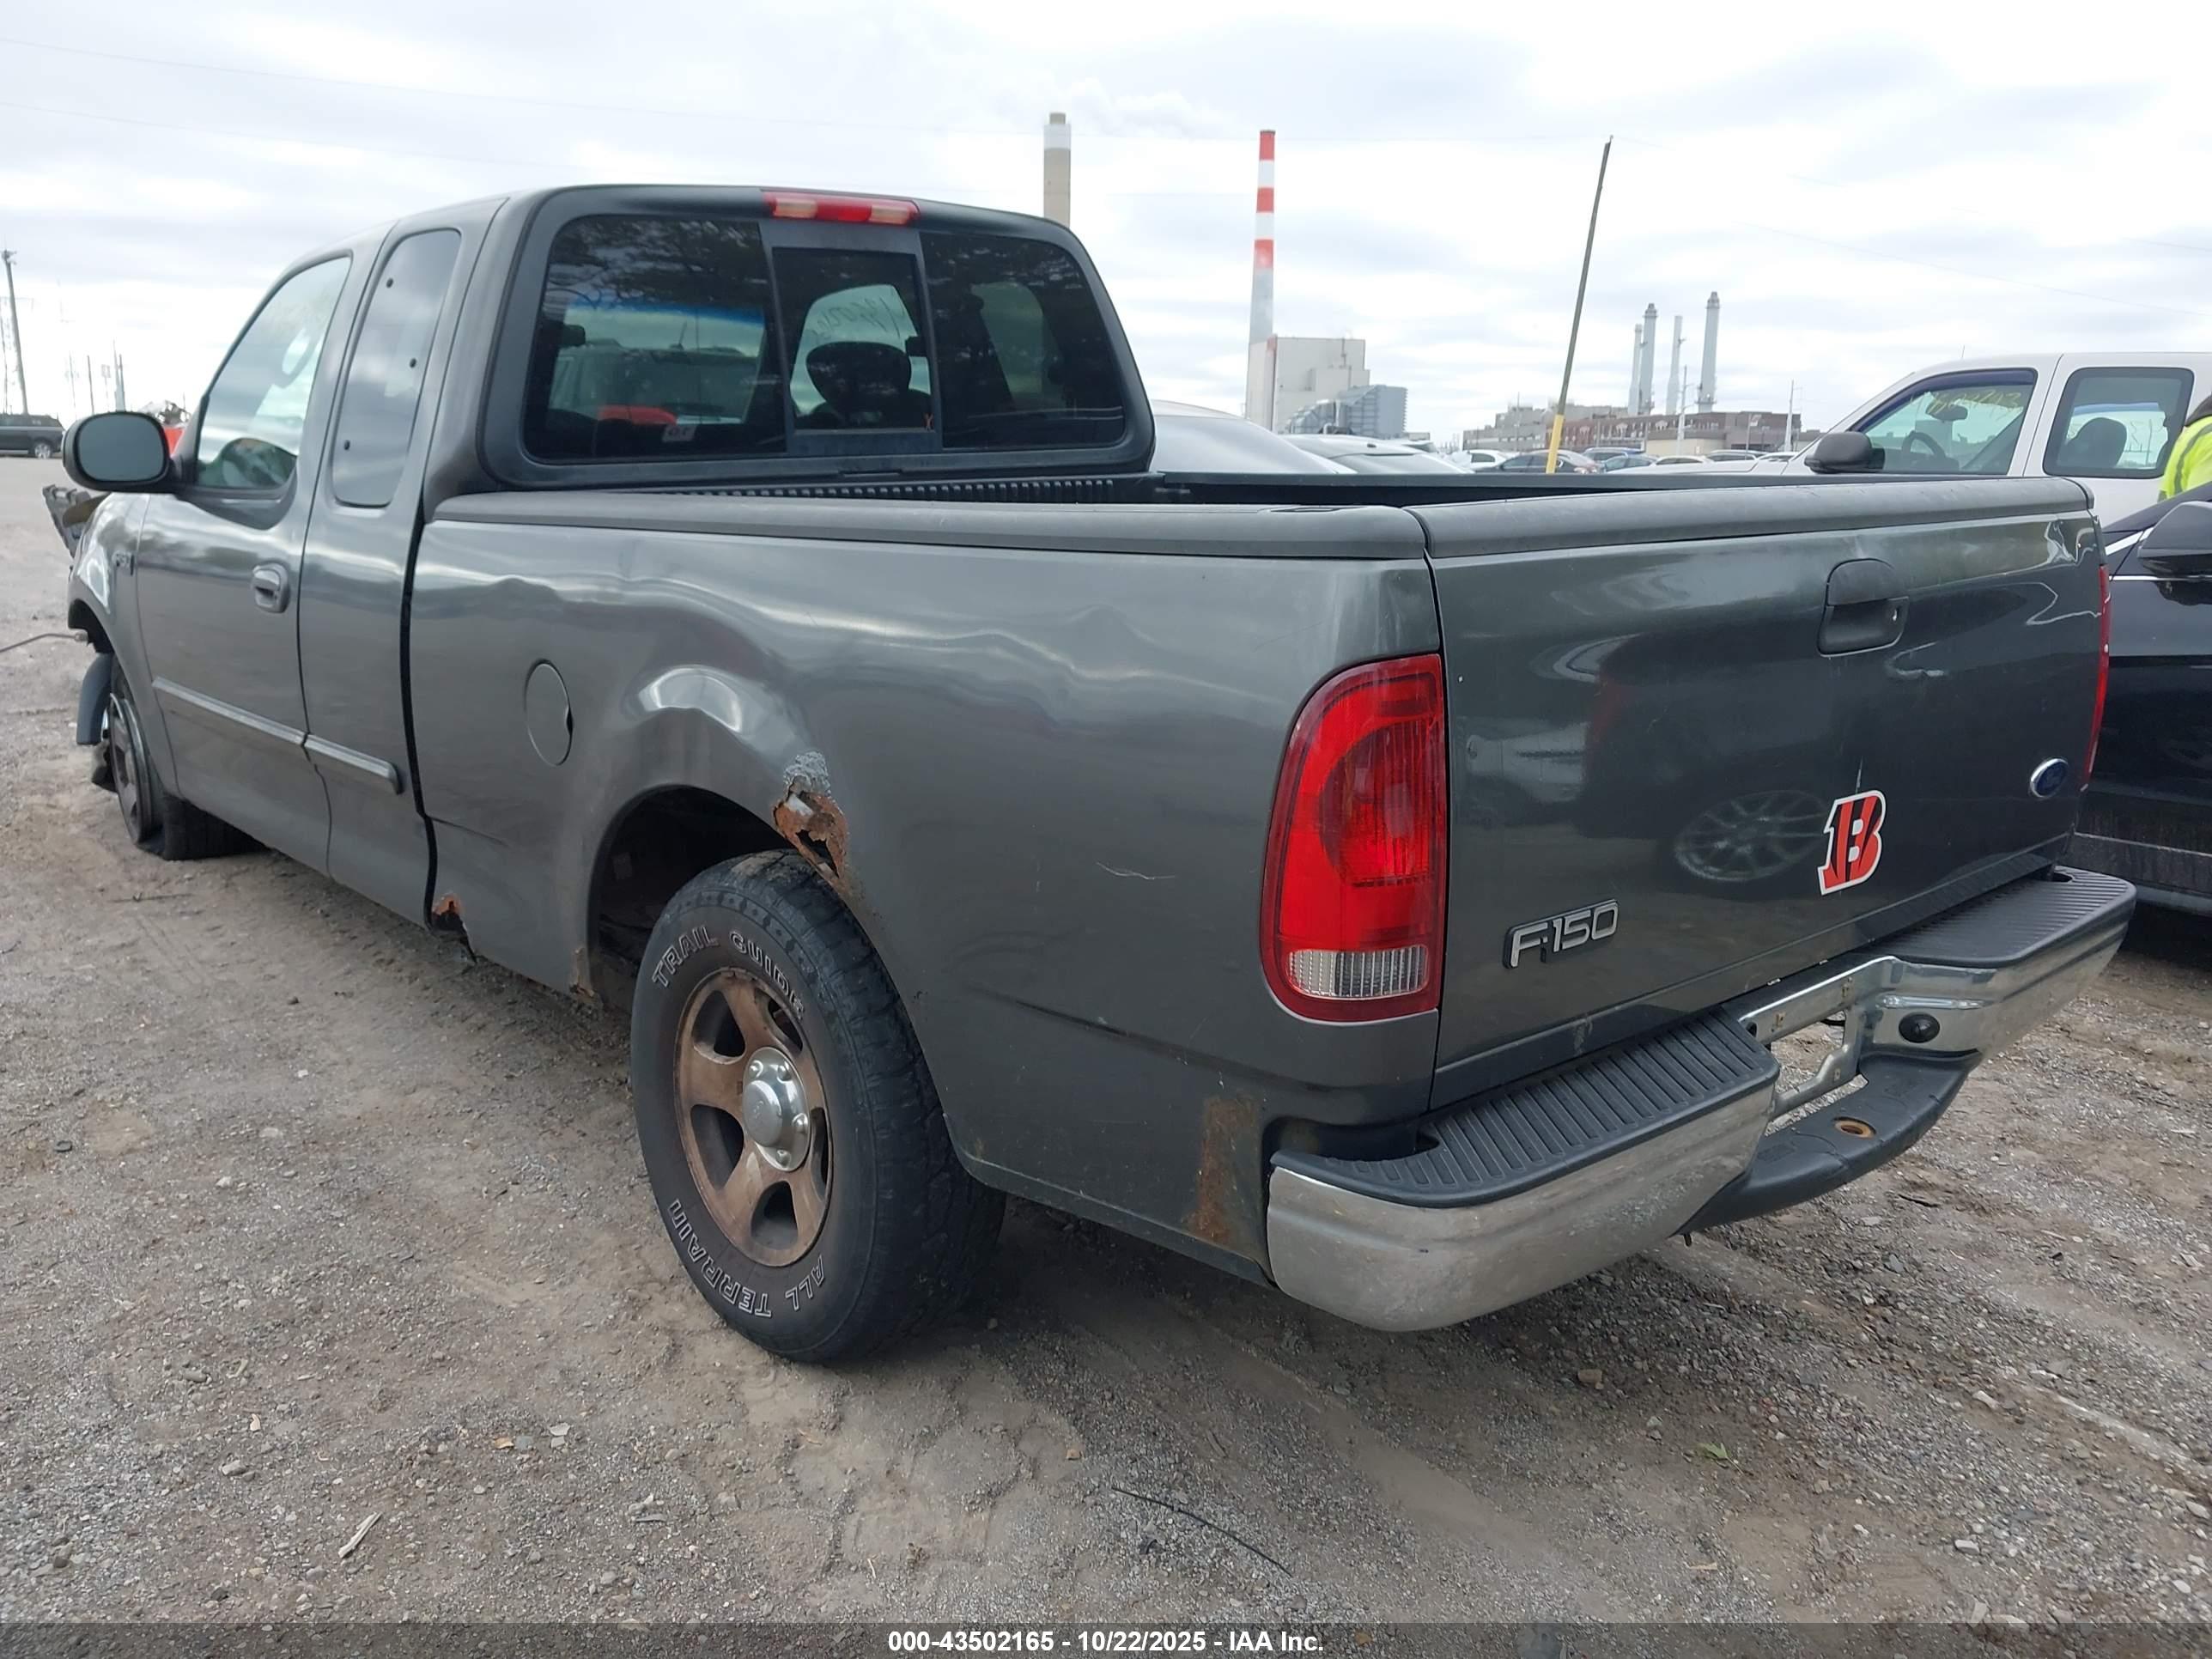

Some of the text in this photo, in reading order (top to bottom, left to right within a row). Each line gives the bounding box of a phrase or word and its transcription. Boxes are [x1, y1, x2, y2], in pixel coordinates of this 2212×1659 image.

[653, 926, 804, 1020] TRAIL GUIDE
[1510, 902, 1619, 968] F-150
[667, 1199, 824, 1317] ALL TERRAIN
